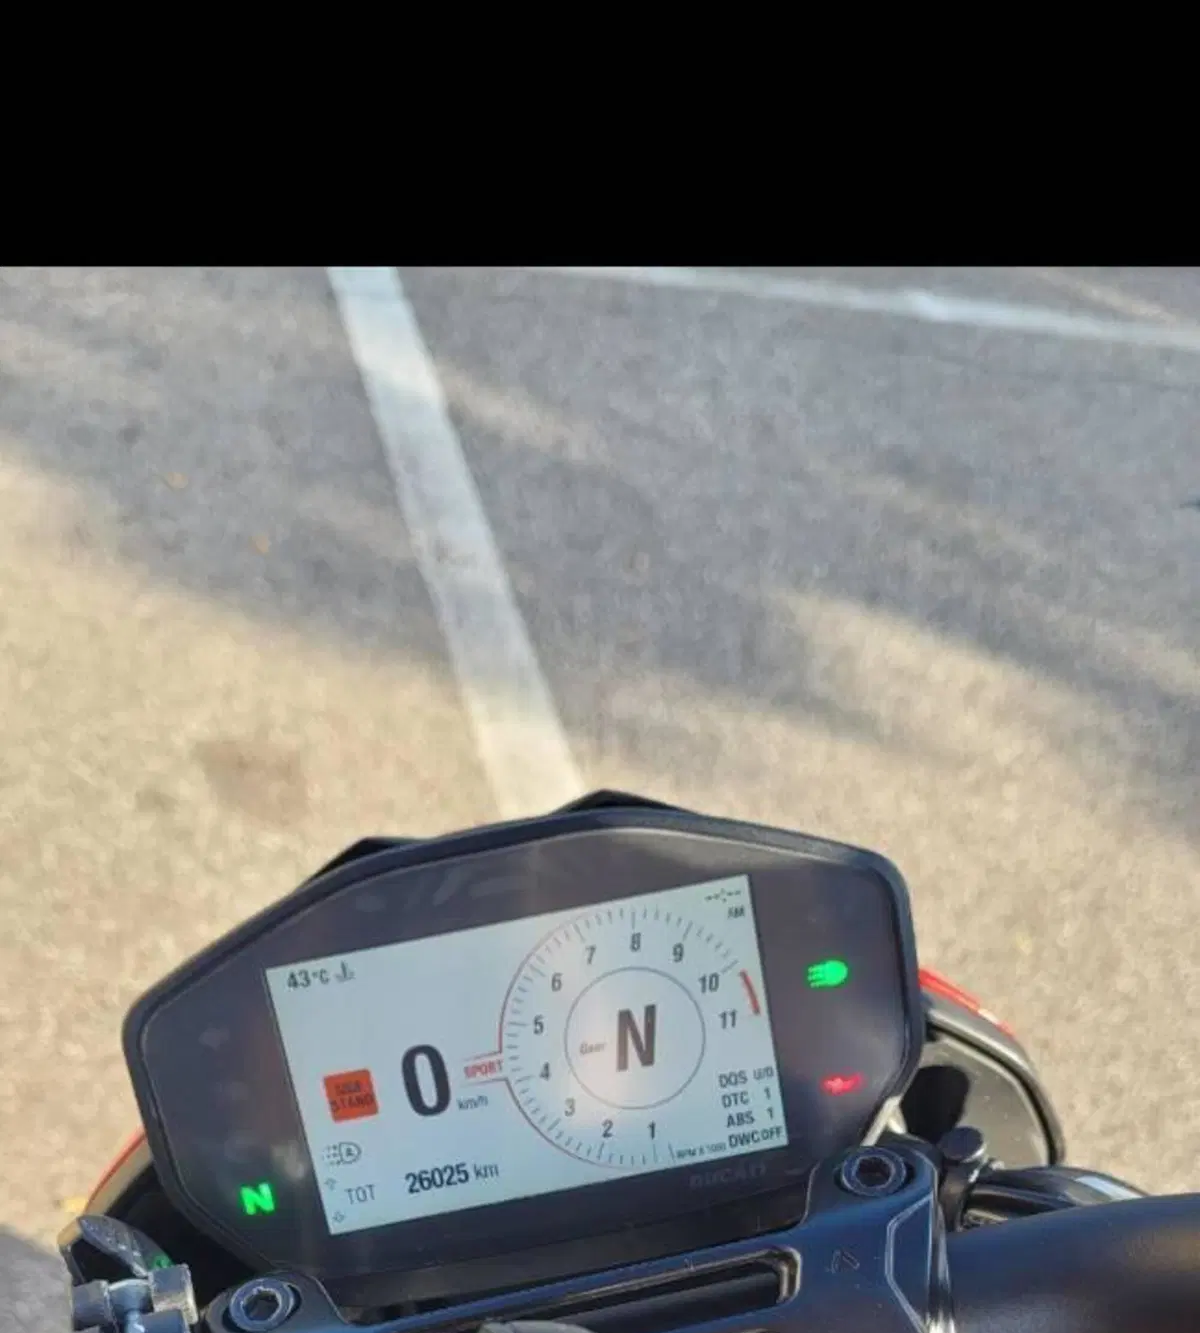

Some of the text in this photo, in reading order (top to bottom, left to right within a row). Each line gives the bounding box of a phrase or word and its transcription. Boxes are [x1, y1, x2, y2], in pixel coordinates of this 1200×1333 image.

[629, 931, 642, 953] 8
[672, 942, 685, 963] 9
[585, 945, 597, 965] 7
[551, 972, 563, 992] 6
[698, 972, 720, 994] 10
[533, 1014, 545, 1035] 5
[718, 1009, 738, 1030] 11
[616, 1003, 657, 1072] N
[463, 1059, 503, 1079] SPORT
[539, 1062, 551, 1082] 4
[401, 1044, 451, 1117] 0
[564, 1098, 577, 1118] 3
[721, 1086, 772, 1109] DTC 1
[726, 1106, 775, 1129] ABS 1
[601, 1119, 614, 1139] 2
[647, 1121, 657, 1140] 1
[728, 1125, 783, 1149] DWC OFF
[344, 1162, 500, 1205] TOT 26025 km
[240, 1183, 275, 1215] N
